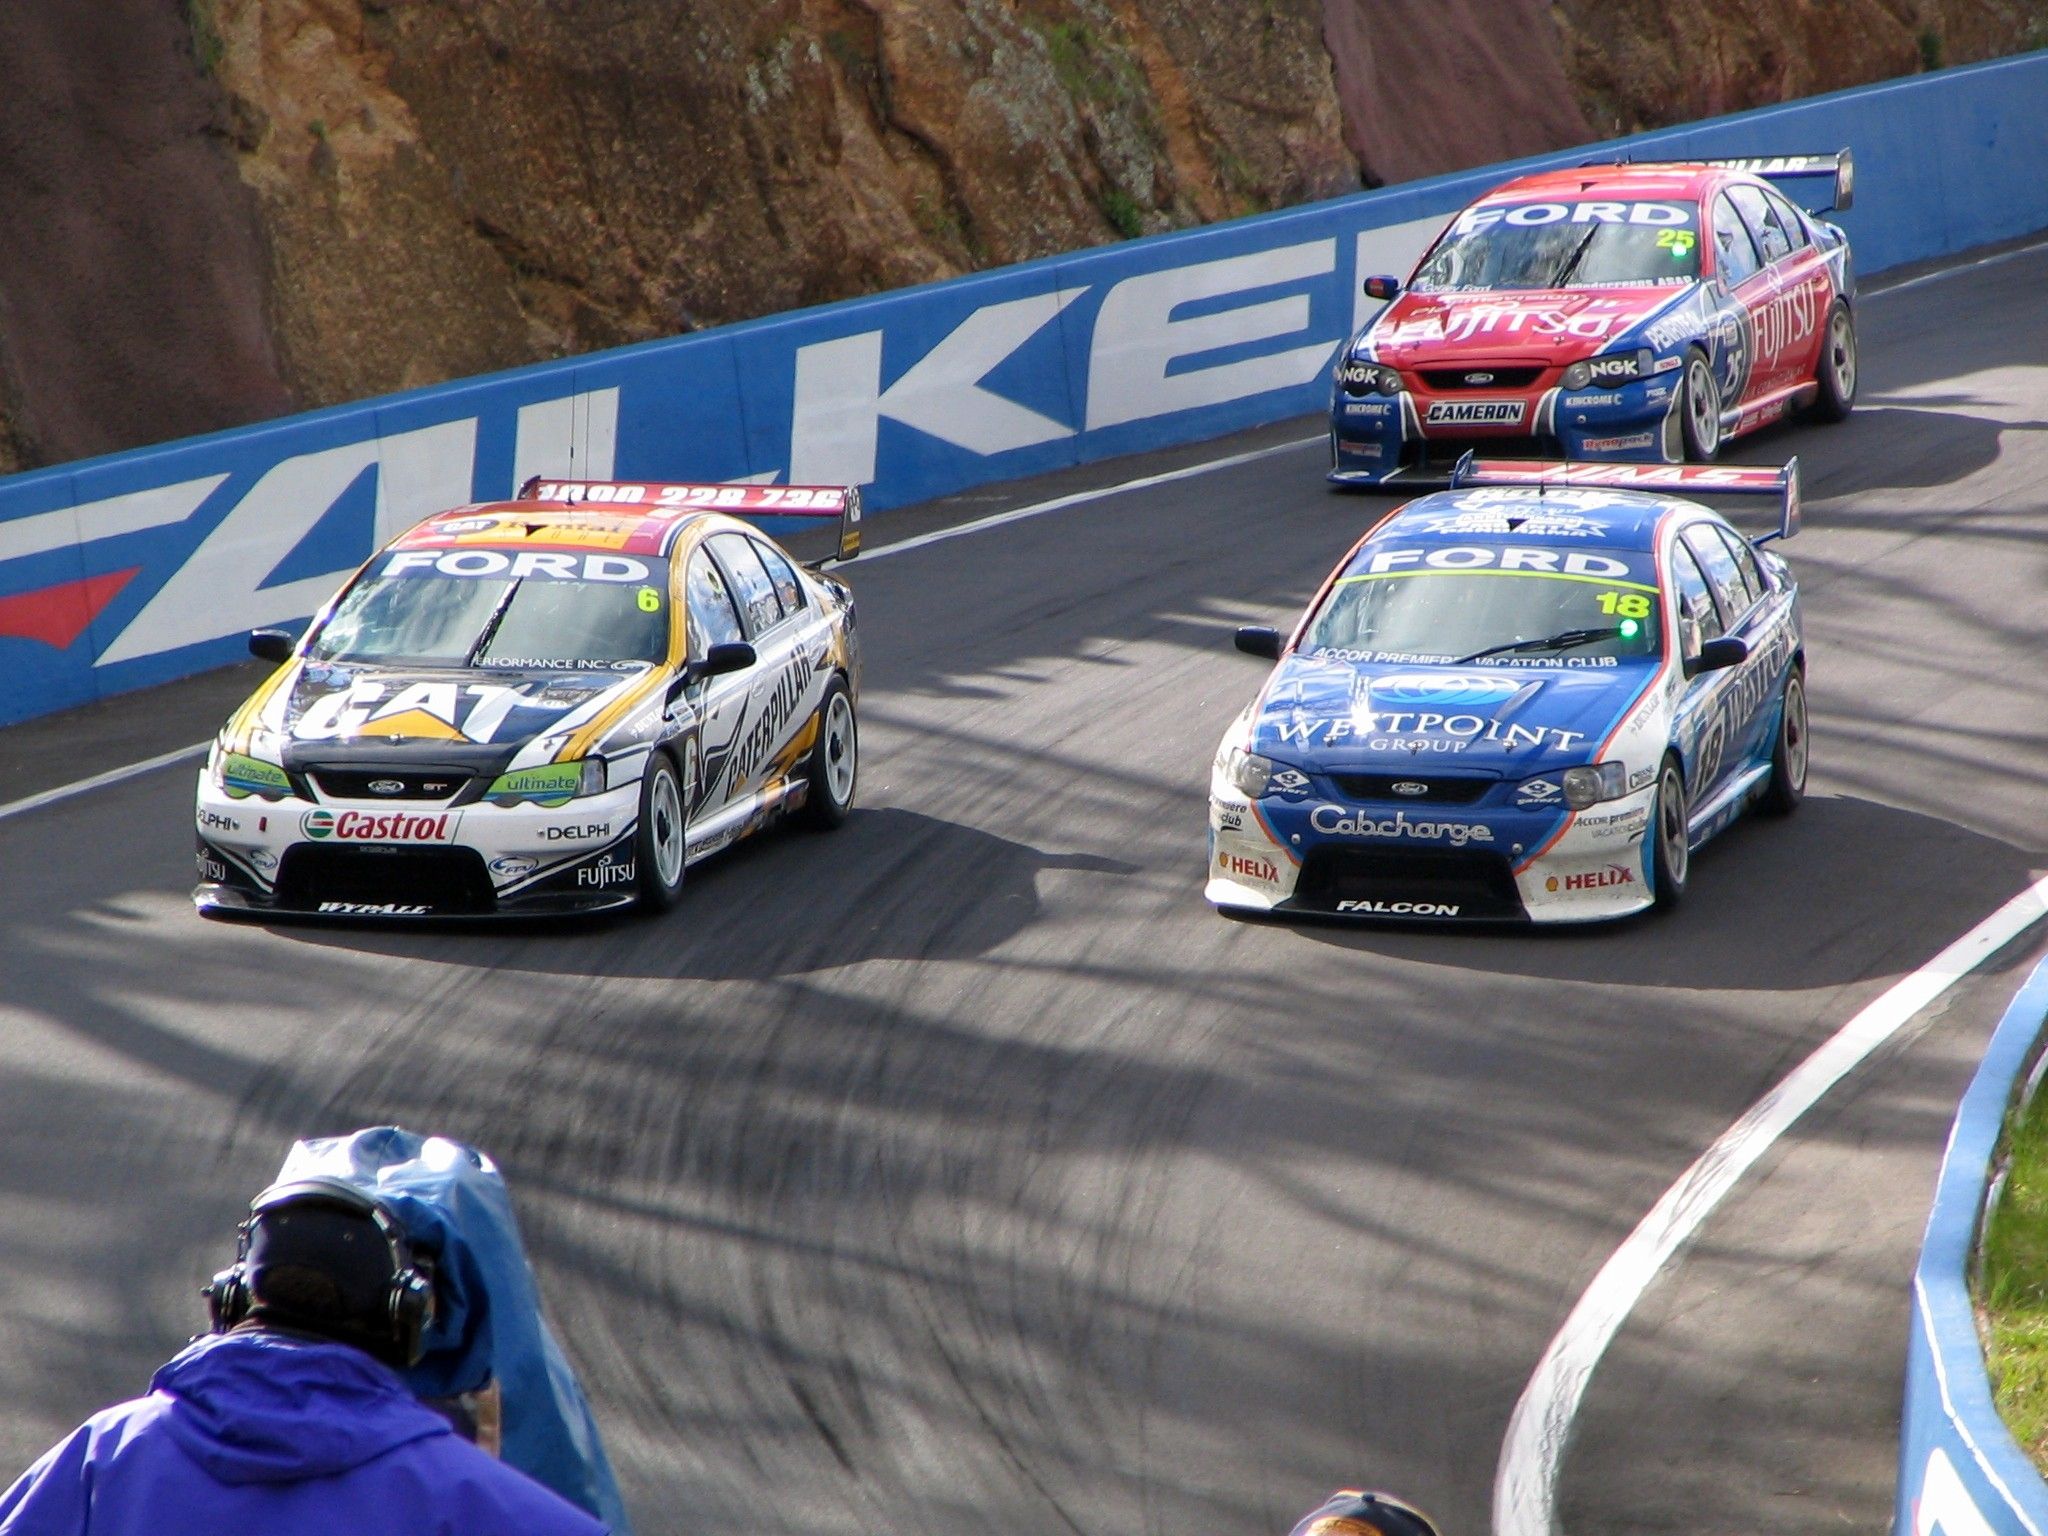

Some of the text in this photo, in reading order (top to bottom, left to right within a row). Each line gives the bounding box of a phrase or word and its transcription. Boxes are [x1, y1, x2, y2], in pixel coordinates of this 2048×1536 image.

[1456, 203, 1689, 235] FORD
[1657, 229, 1694, 250] 25
[1753, 276, 1815, 371] FUJITSU
[1344, 367, 1379, 384] NGK
[1590, 360, 1638, 378] NGK
[1429, 404, 1522, 421] CAMERON
[538, 484, 646, 503] 1800
[654, 486, 747, 507] 228
[755, 489, 842, 508] 736
[382, 551, 649, 583] FORD
[1369, 548, 1630, 577] FORD
[636, 587, 660, 613] 6
[1596, 591, 1650, 618] 18
[474, 656, 572, 669] ERFORMANCE
[1313, 647, 1374, 662] ACCOR
[1476, 657, 1564, 668] VACATION
[1567, 656, 1618, 668] CLUB
[293, 682, 539, 744] CAT
[724, 642, 812, 804] CATERPILLAR
[1370, 738, 1467, 754] GROUP
[507, 775, 575, 790] ultimate
[337, 811, 448, 840] Castrol
[547, 823, 610, 840] DELPHI
[1310, 804, 1494, 846] Cabcharge
[578, 856, 635, 889] FUJITSU
[1232, 856, 1280, 883] HELIX
[1566, 864, 1636, 890] HELIX
[318, 902, 428, 915] WYPALL
[1336, 900, 1460, 916] FALCON
